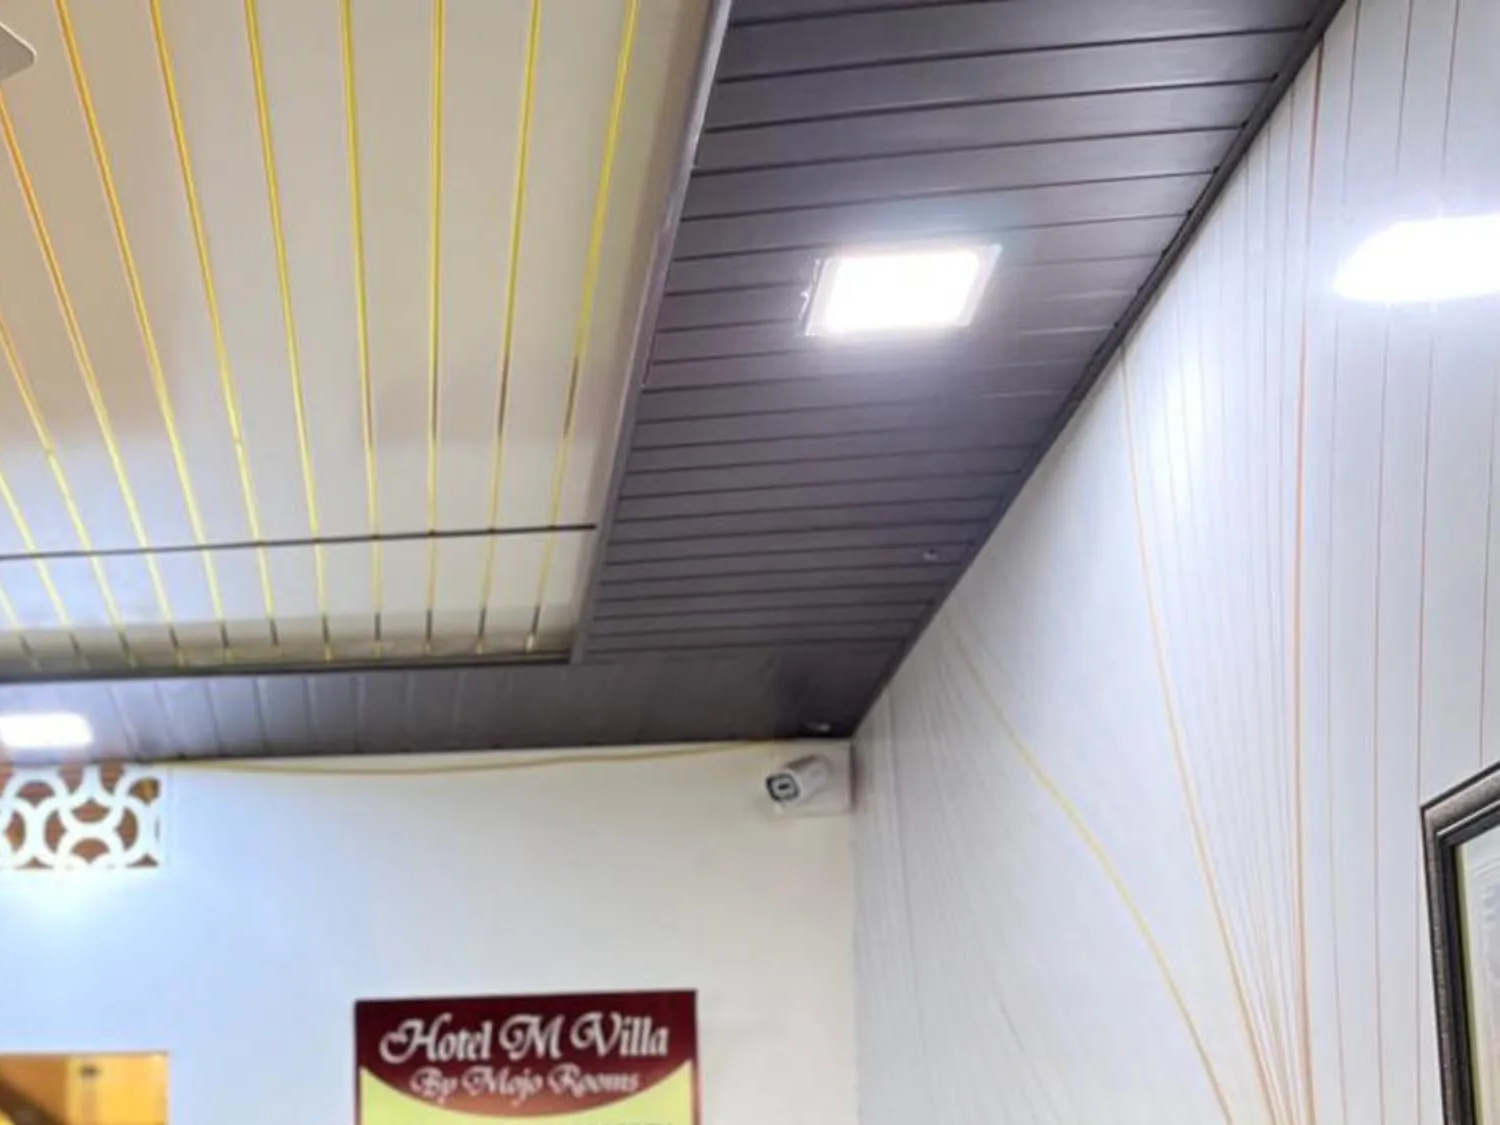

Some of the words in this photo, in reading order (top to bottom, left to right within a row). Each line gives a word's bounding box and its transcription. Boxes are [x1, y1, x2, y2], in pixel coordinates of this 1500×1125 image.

[379, 1013, 492, 1064] Hotel
[499, 1014, 566, 1062] M
[570, 1011, 670, 1057] Villa
[410, 1066, 460, 1103] By
[462, 1065, 544, 1107] Mojo
[547, 1062, 640, 1095] Rooms
